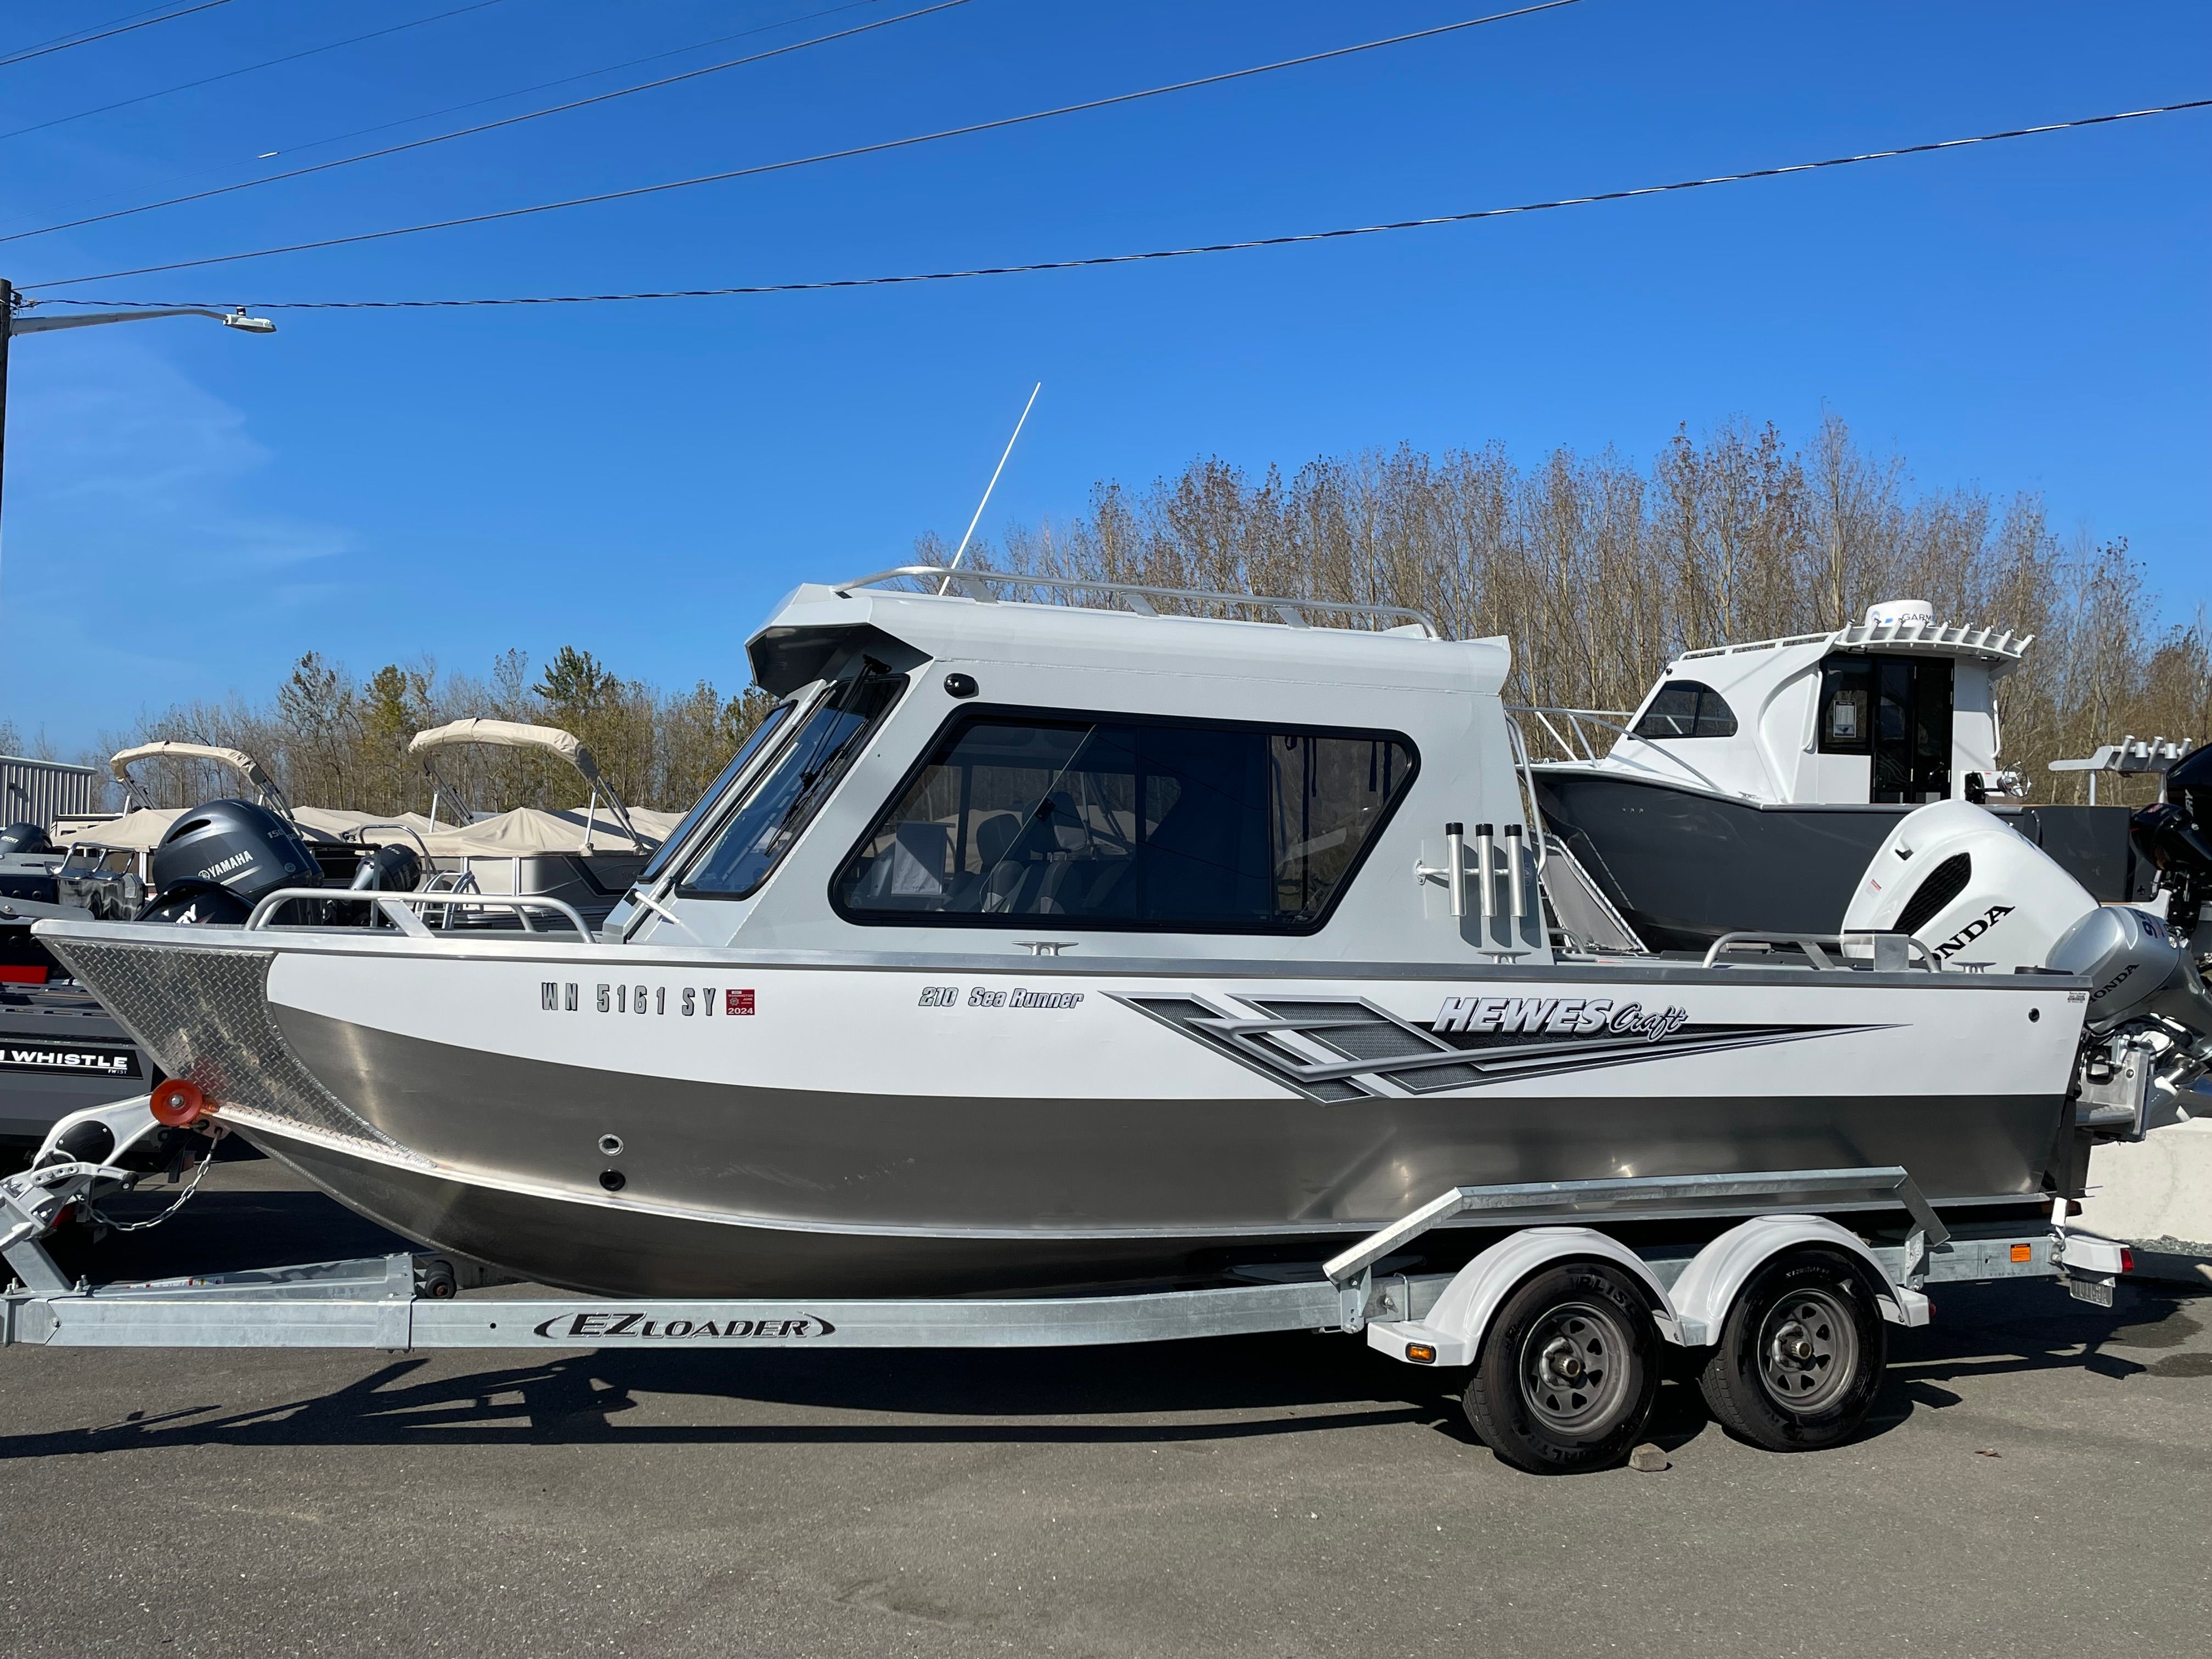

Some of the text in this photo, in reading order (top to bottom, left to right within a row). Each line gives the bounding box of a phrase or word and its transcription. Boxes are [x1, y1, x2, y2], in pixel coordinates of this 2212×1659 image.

[267, 829, 284, 838] 150
[208, 850, 253, 878] YAMAHA
[541, 982, 716, 1016] WN 5161 SY
[918, 986, 1085, 1009] 210 Sea Runner
[1431, 997, 1688, 1042] HEWES Craft
[11, 1050, 128, 1068] WHISTLE
